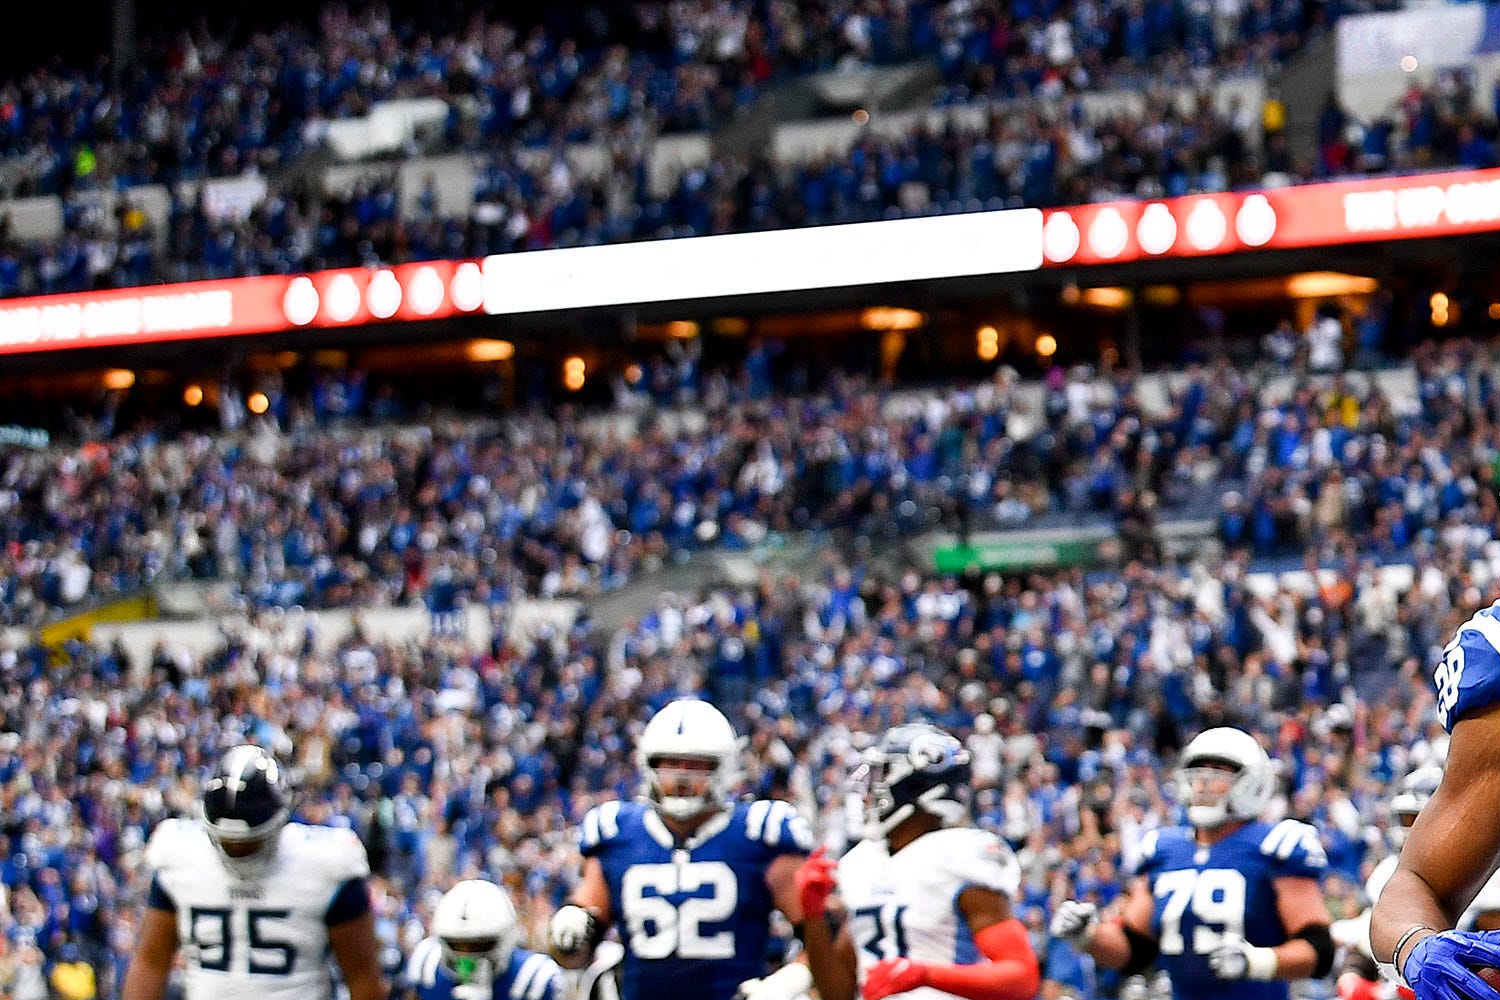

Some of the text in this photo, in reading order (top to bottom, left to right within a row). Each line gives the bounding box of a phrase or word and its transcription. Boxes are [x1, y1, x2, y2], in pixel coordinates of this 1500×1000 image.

[191, 906, 295, 975] 95
[621, 861, 738, 960] 62
[1154, 868, 1246, 956] 79
